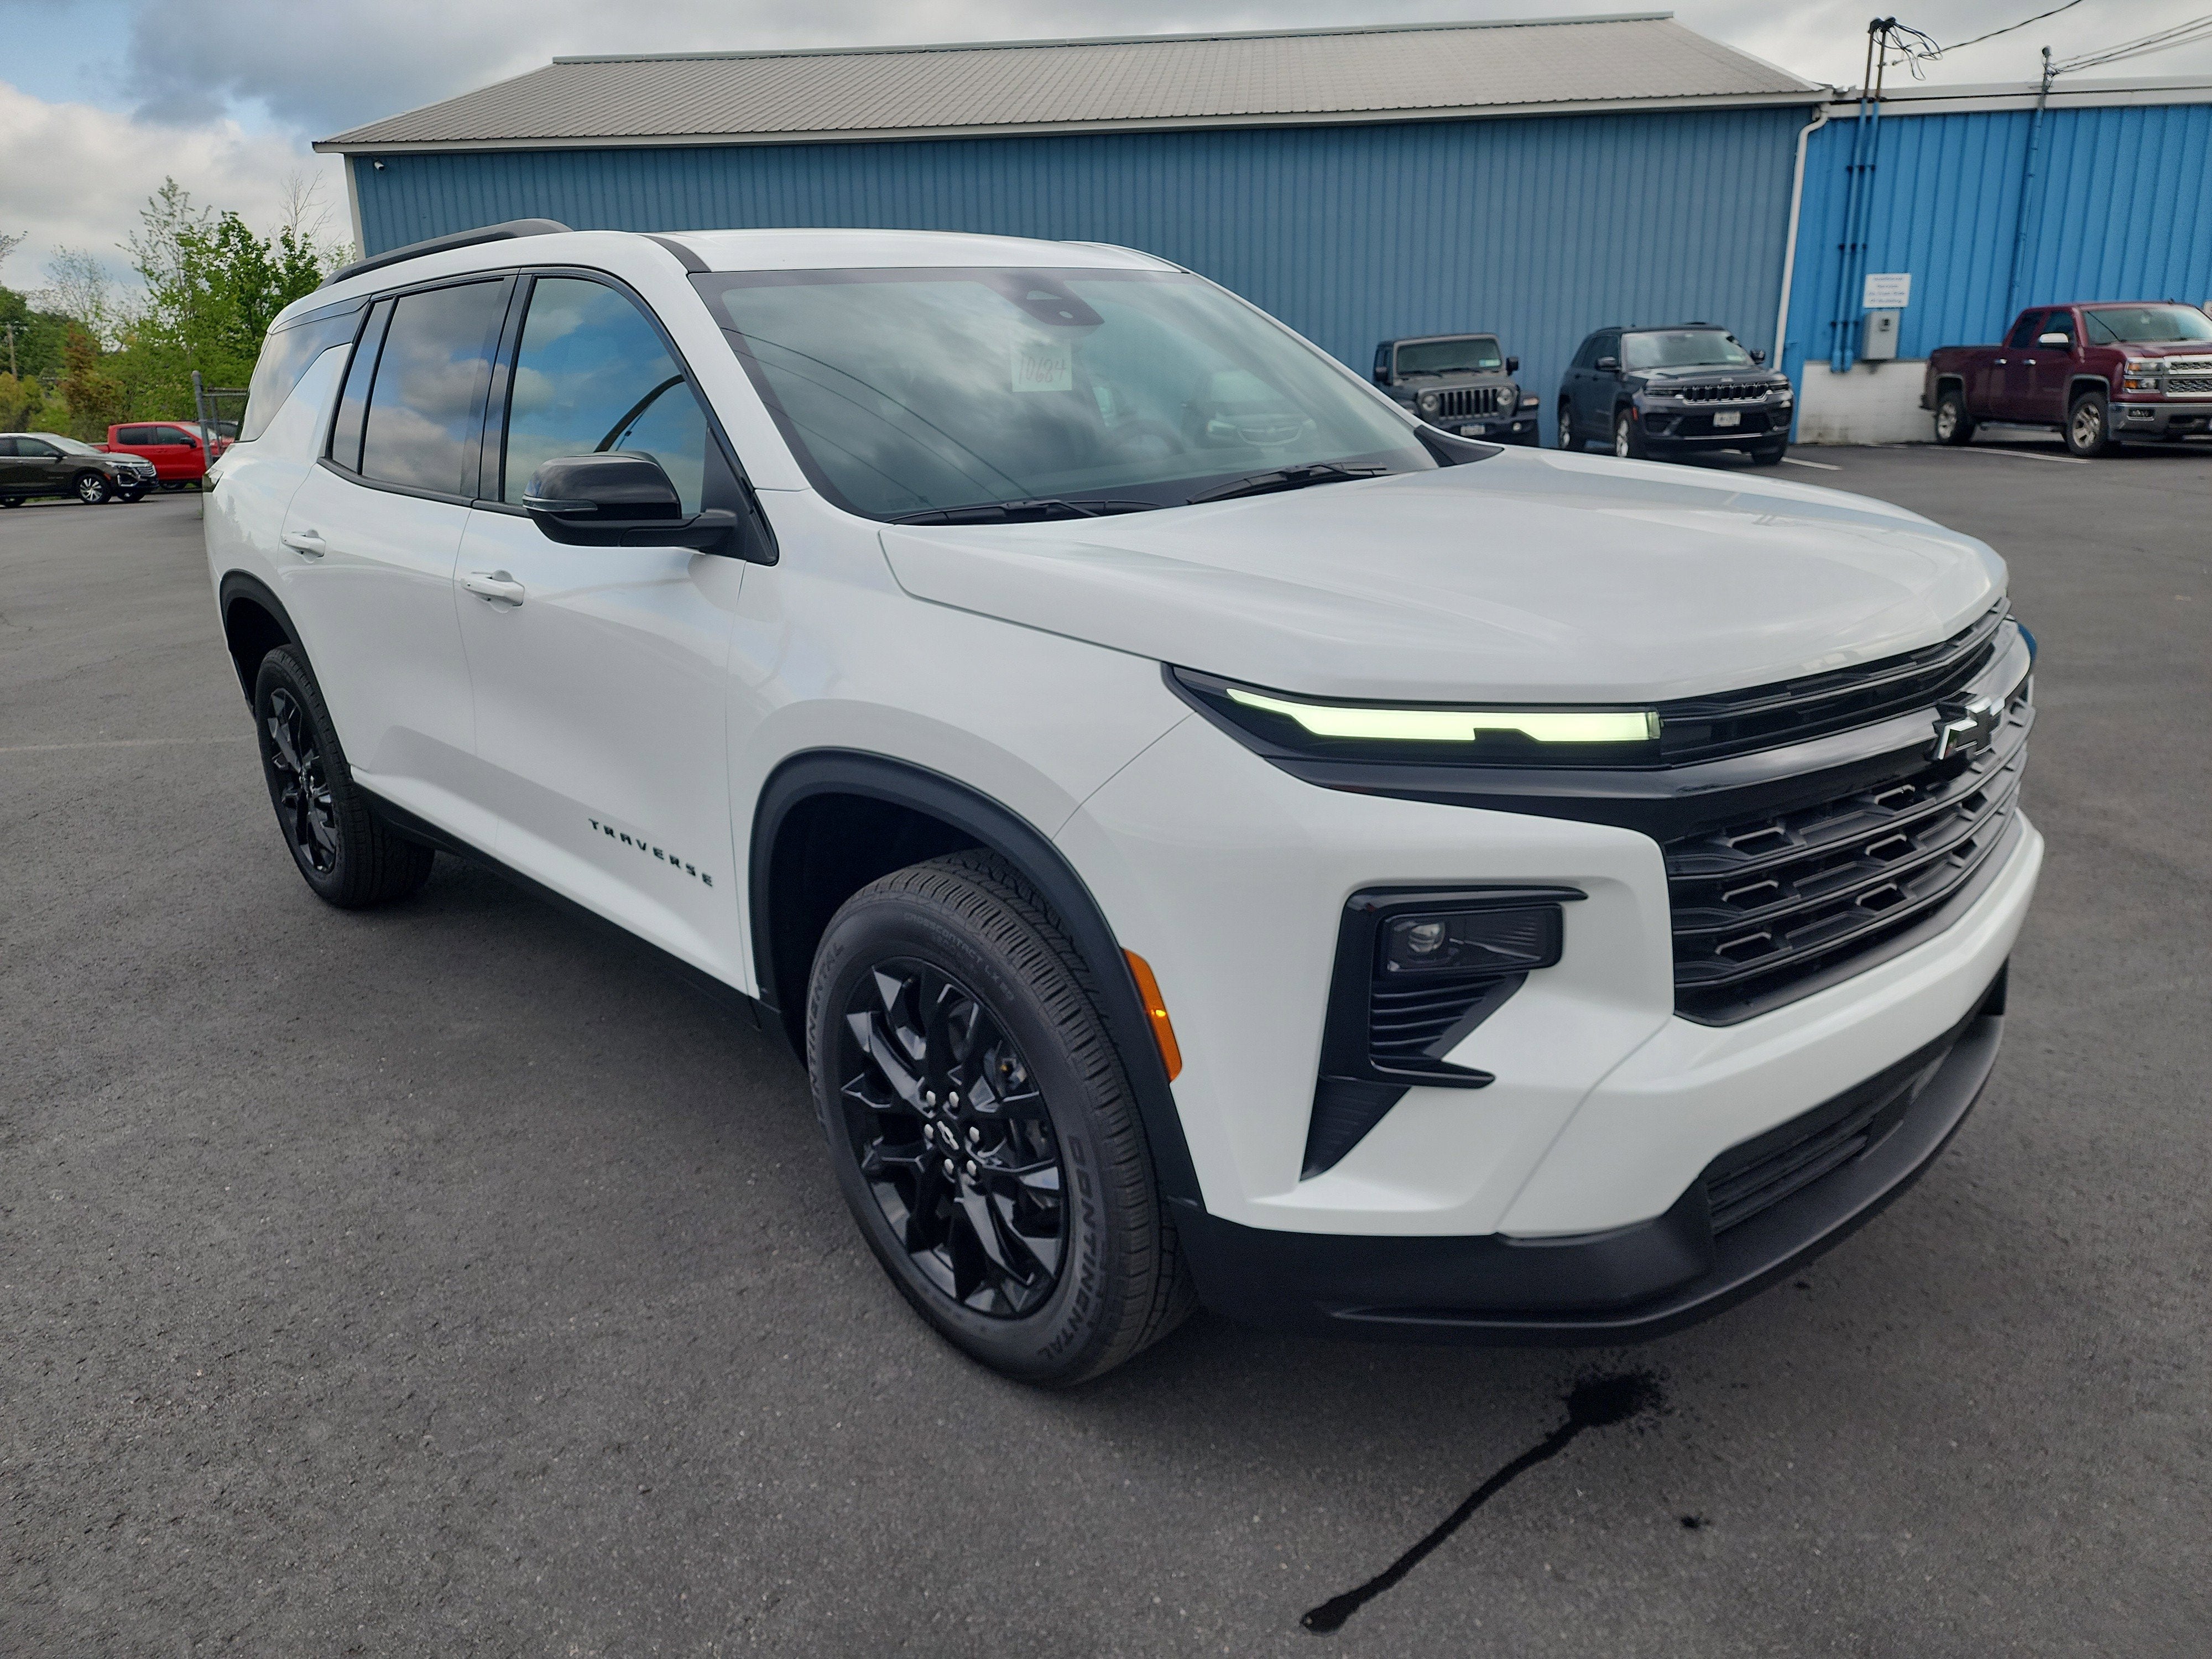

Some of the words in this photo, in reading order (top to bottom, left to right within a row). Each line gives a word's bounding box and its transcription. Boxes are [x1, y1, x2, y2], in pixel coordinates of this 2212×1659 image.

[1019, 353, 1066, 385] 10684
[588, 818, 713, 887] TRAVERSE
[1036, 1134, 1097, 1361] CONTINENTAL
